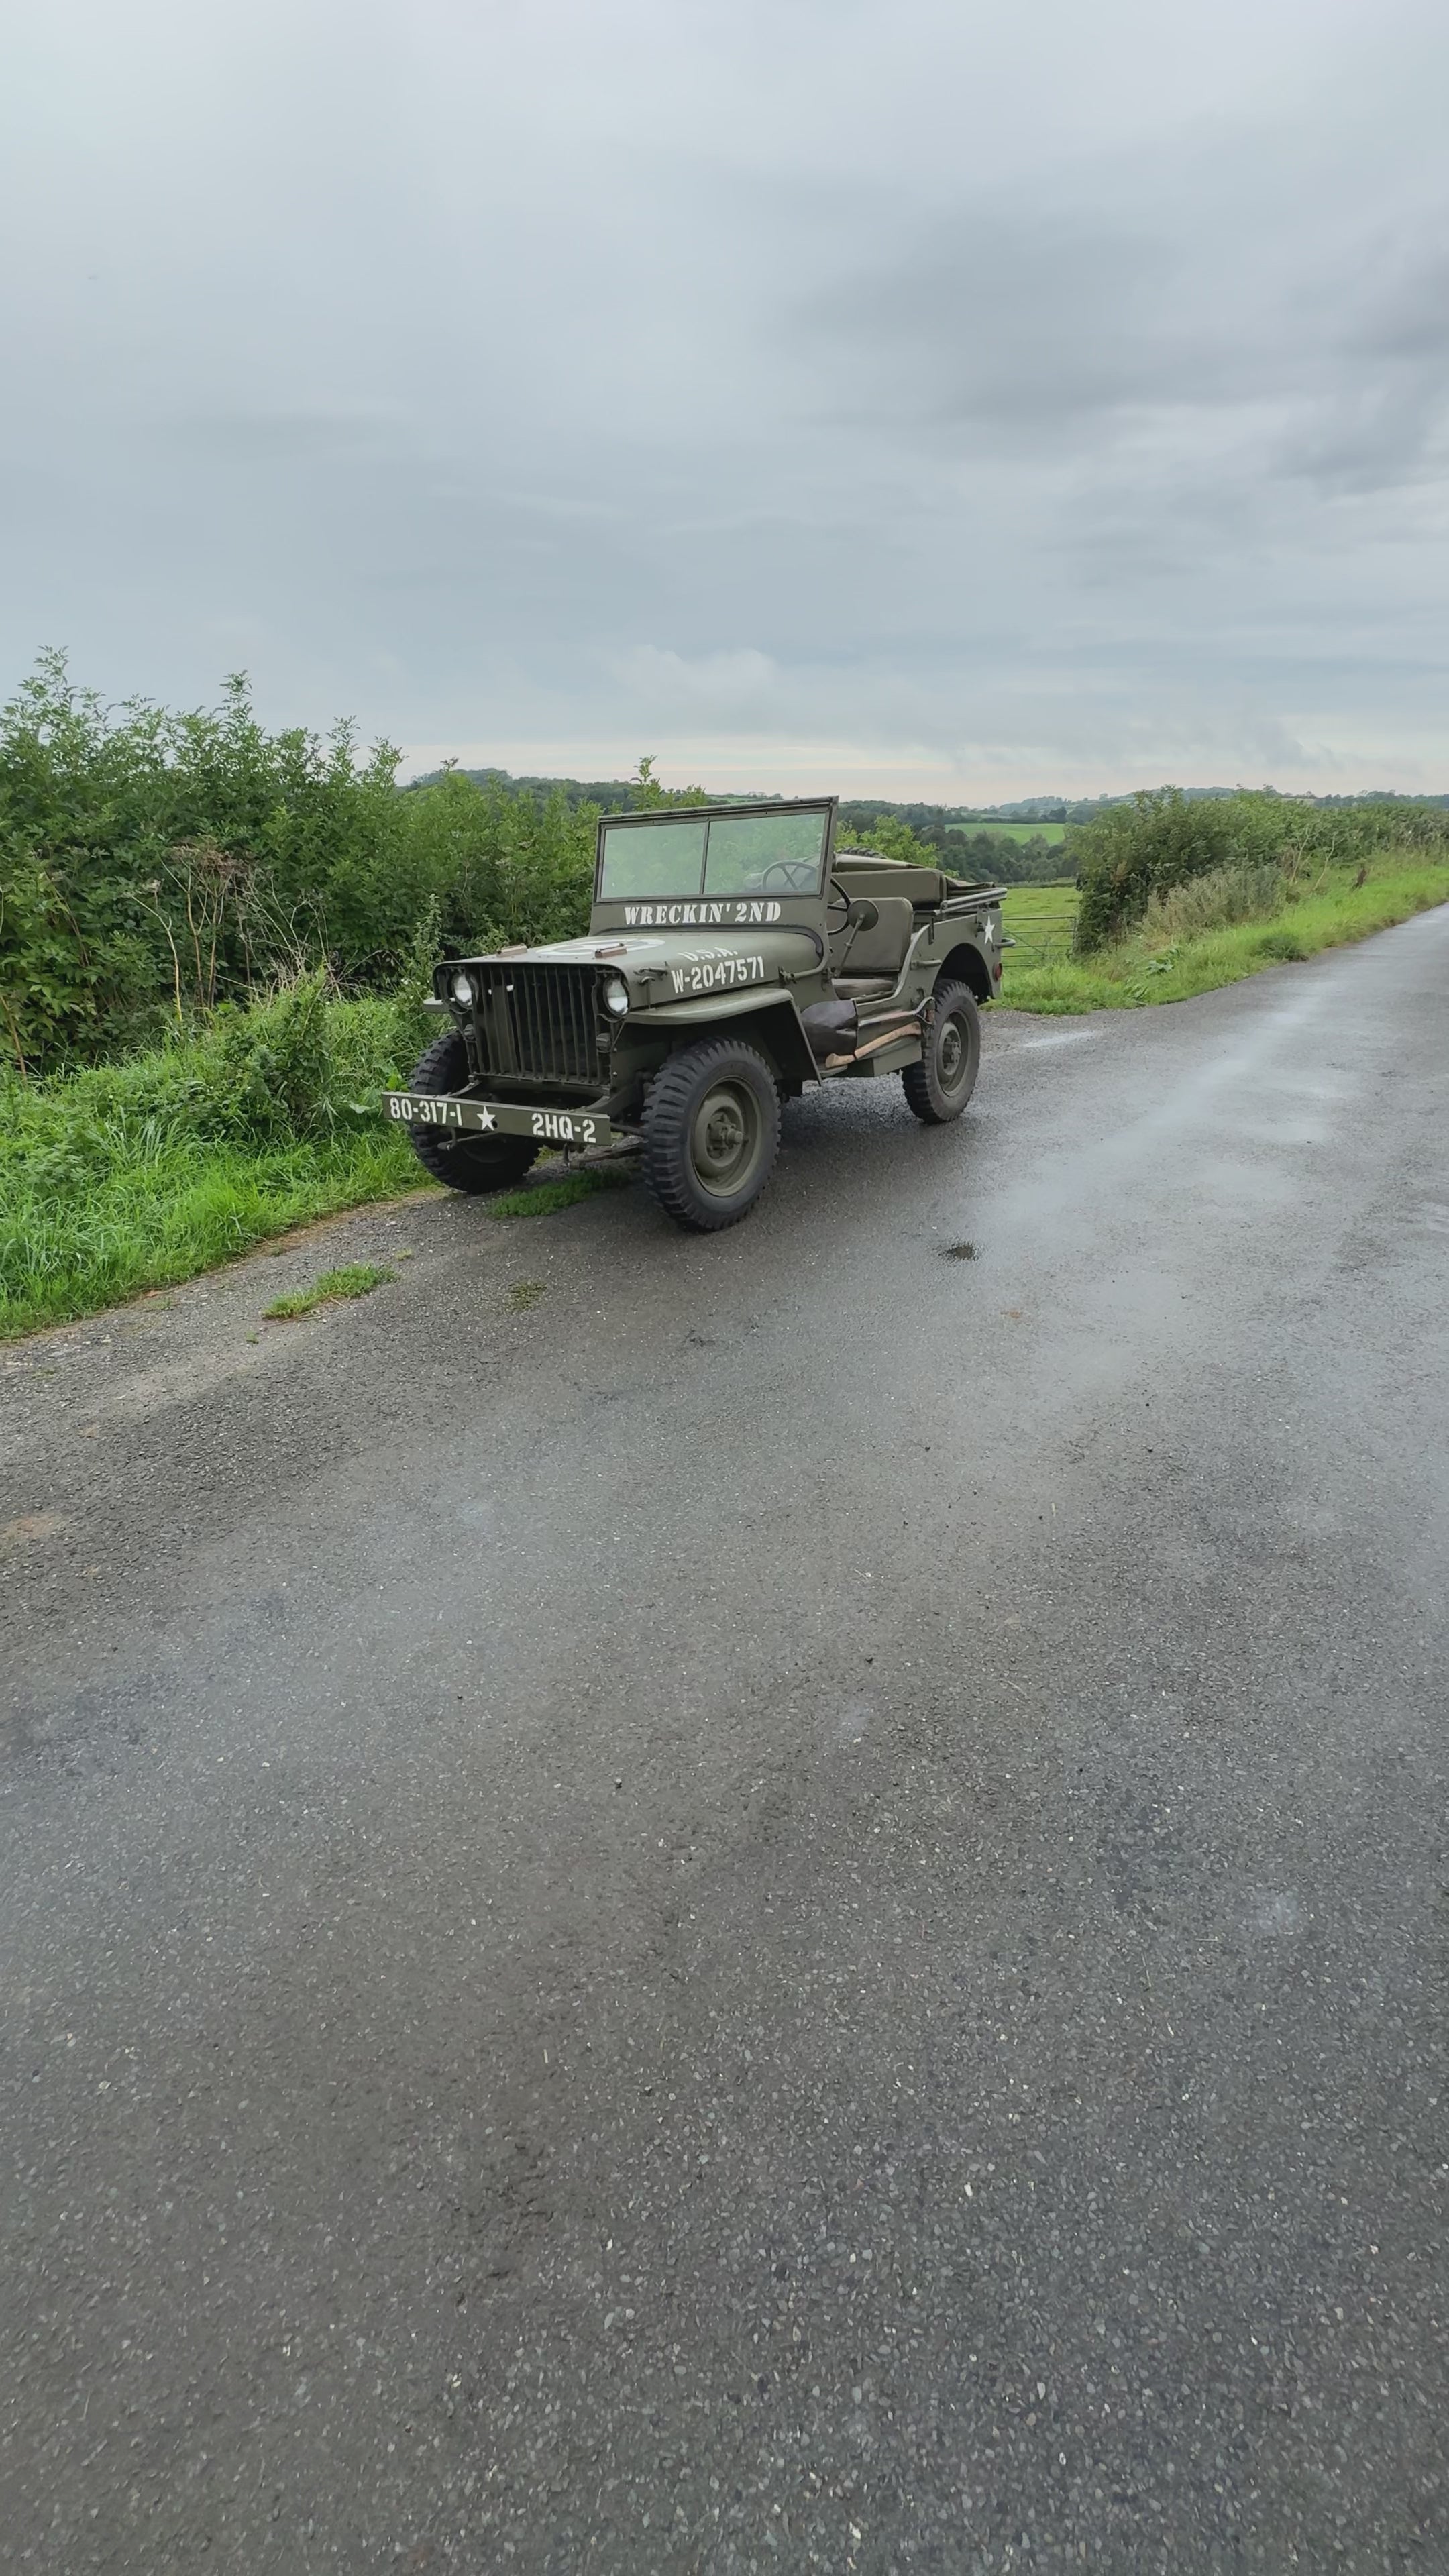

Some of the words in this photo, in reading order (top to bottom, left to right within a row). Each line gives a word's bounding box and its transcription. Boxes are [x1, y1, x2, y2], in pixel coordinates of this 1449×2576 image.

[624, 903, 731, 925] WRECKIN'
[735, 902, 782, 922] 2ND
[678, 947, 738, 961] U.S.A.
[671, 955, 765, 994] W-2047571
[531, 1112, 596, 1143] 2HQ-2
